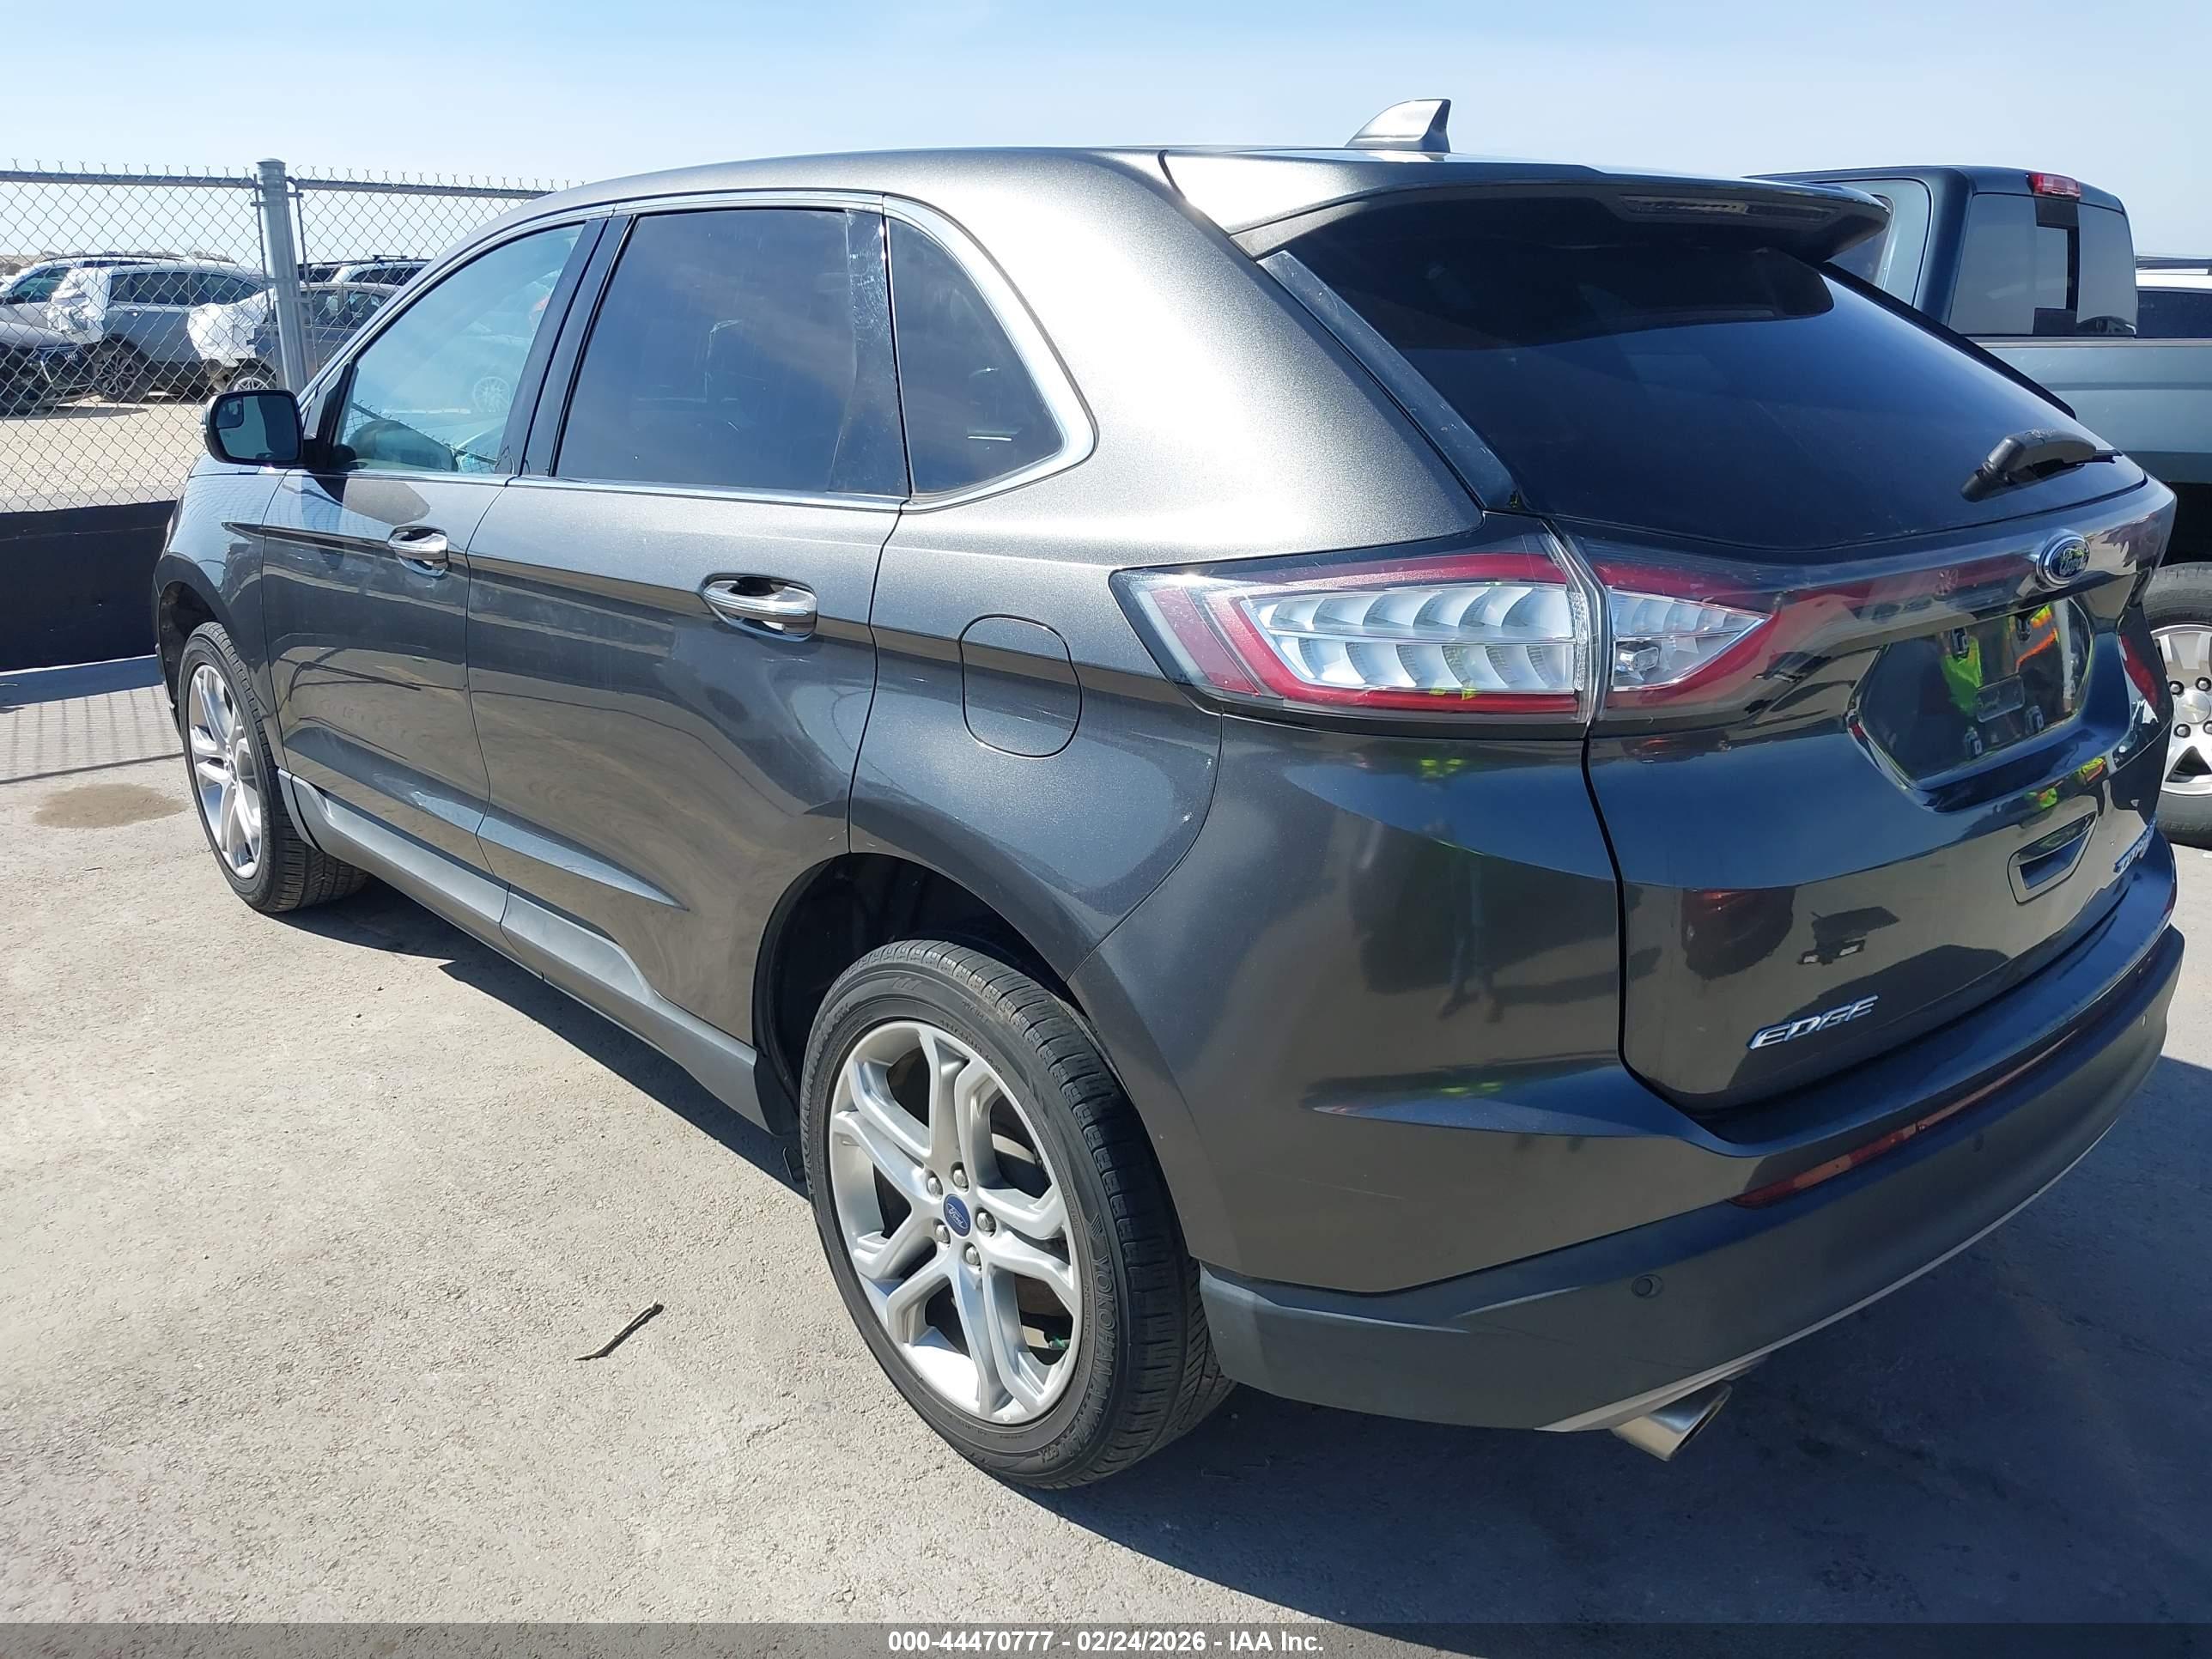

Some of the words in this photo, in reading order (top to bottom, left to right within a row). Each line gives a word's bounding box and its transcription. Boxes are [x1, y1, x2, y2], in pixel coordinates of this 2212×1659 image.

[1747, 994, 1879, 1049] EDGE
[947, 1204, 964, 1225] Ford
[1088, 1254, 1115, 1400] YOKOHAMA
